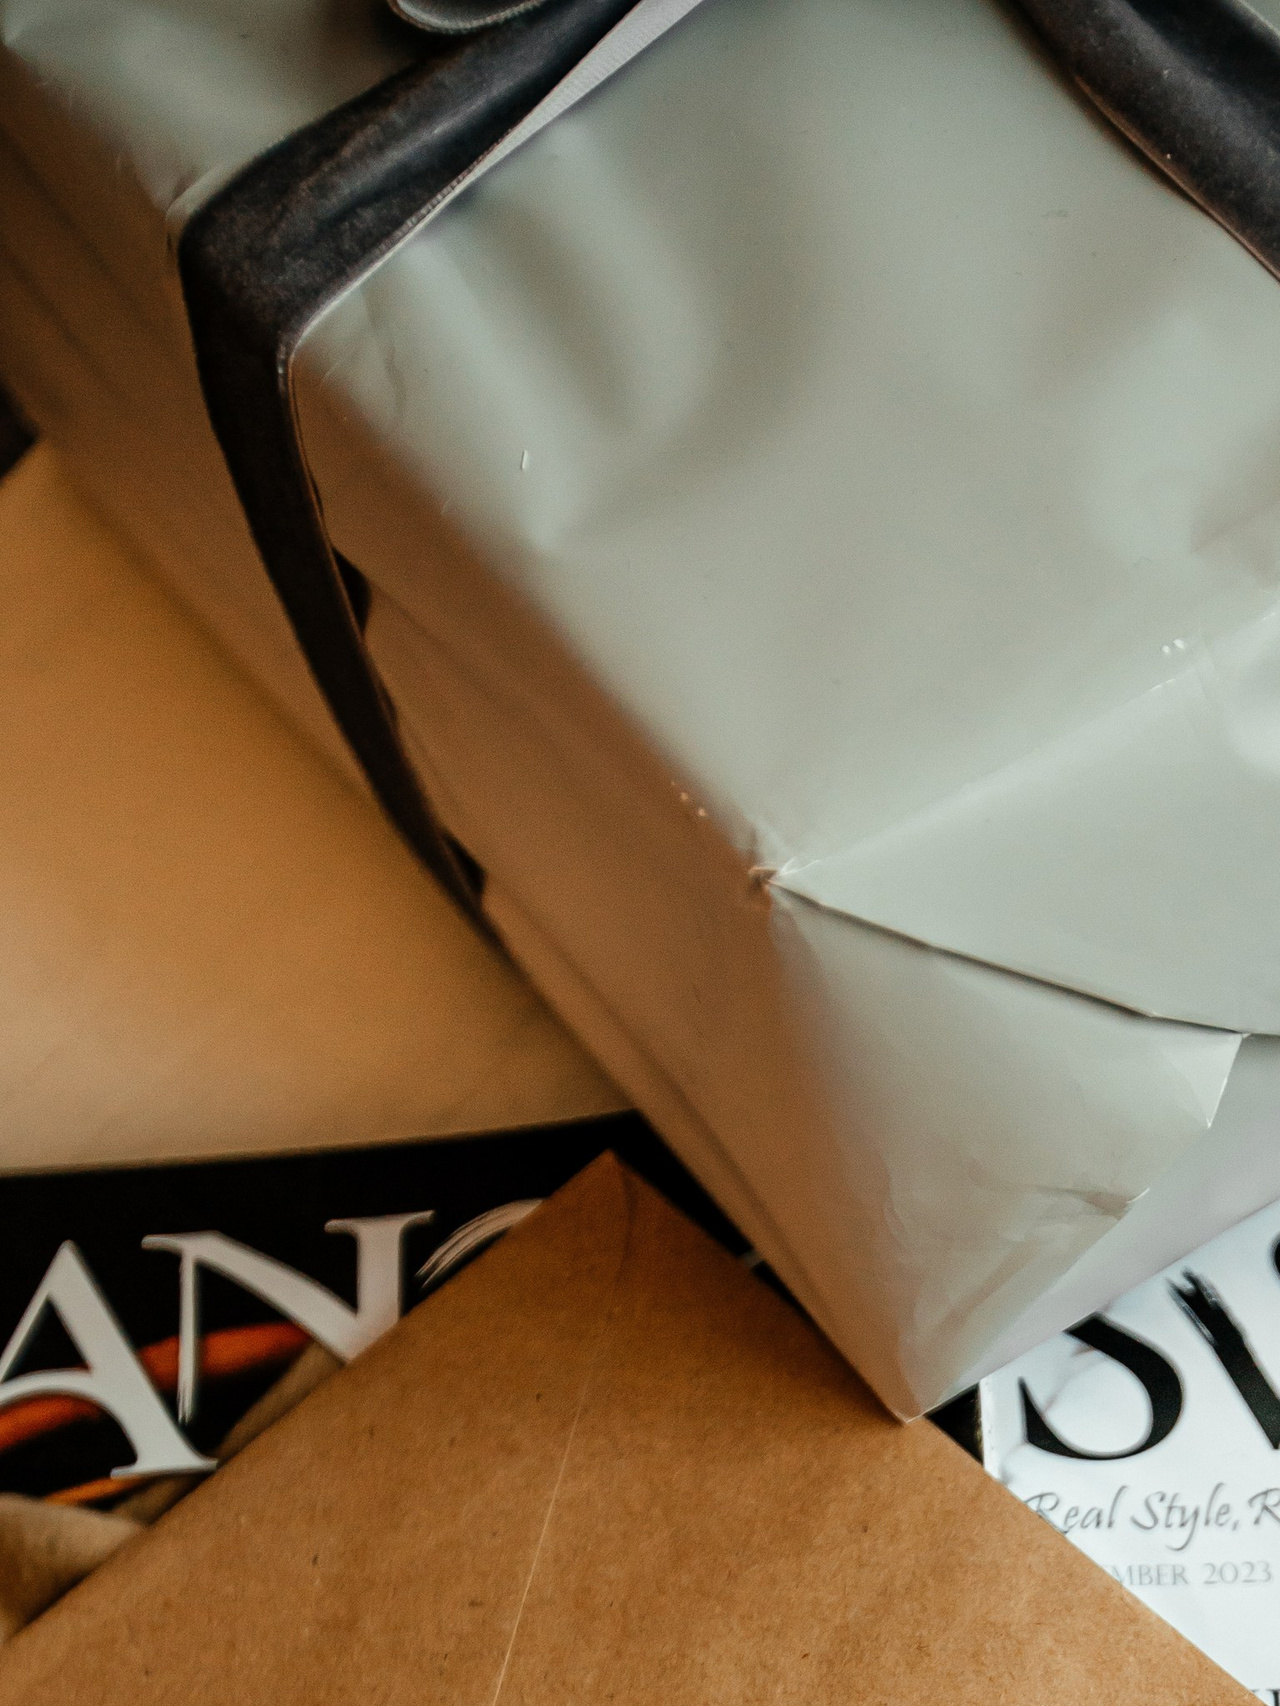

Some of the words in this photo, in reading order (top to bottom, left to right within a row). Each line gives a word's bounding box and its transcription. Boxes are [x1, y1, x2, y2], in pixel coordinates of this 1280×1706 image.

[1024, 1484, 1129, 1534] Real
[1130, 1481, 1240, 1550] Style,
[1104, 1562, 1189, 1586] MBER
[1203, 1560, 1272, 1585] 2023
